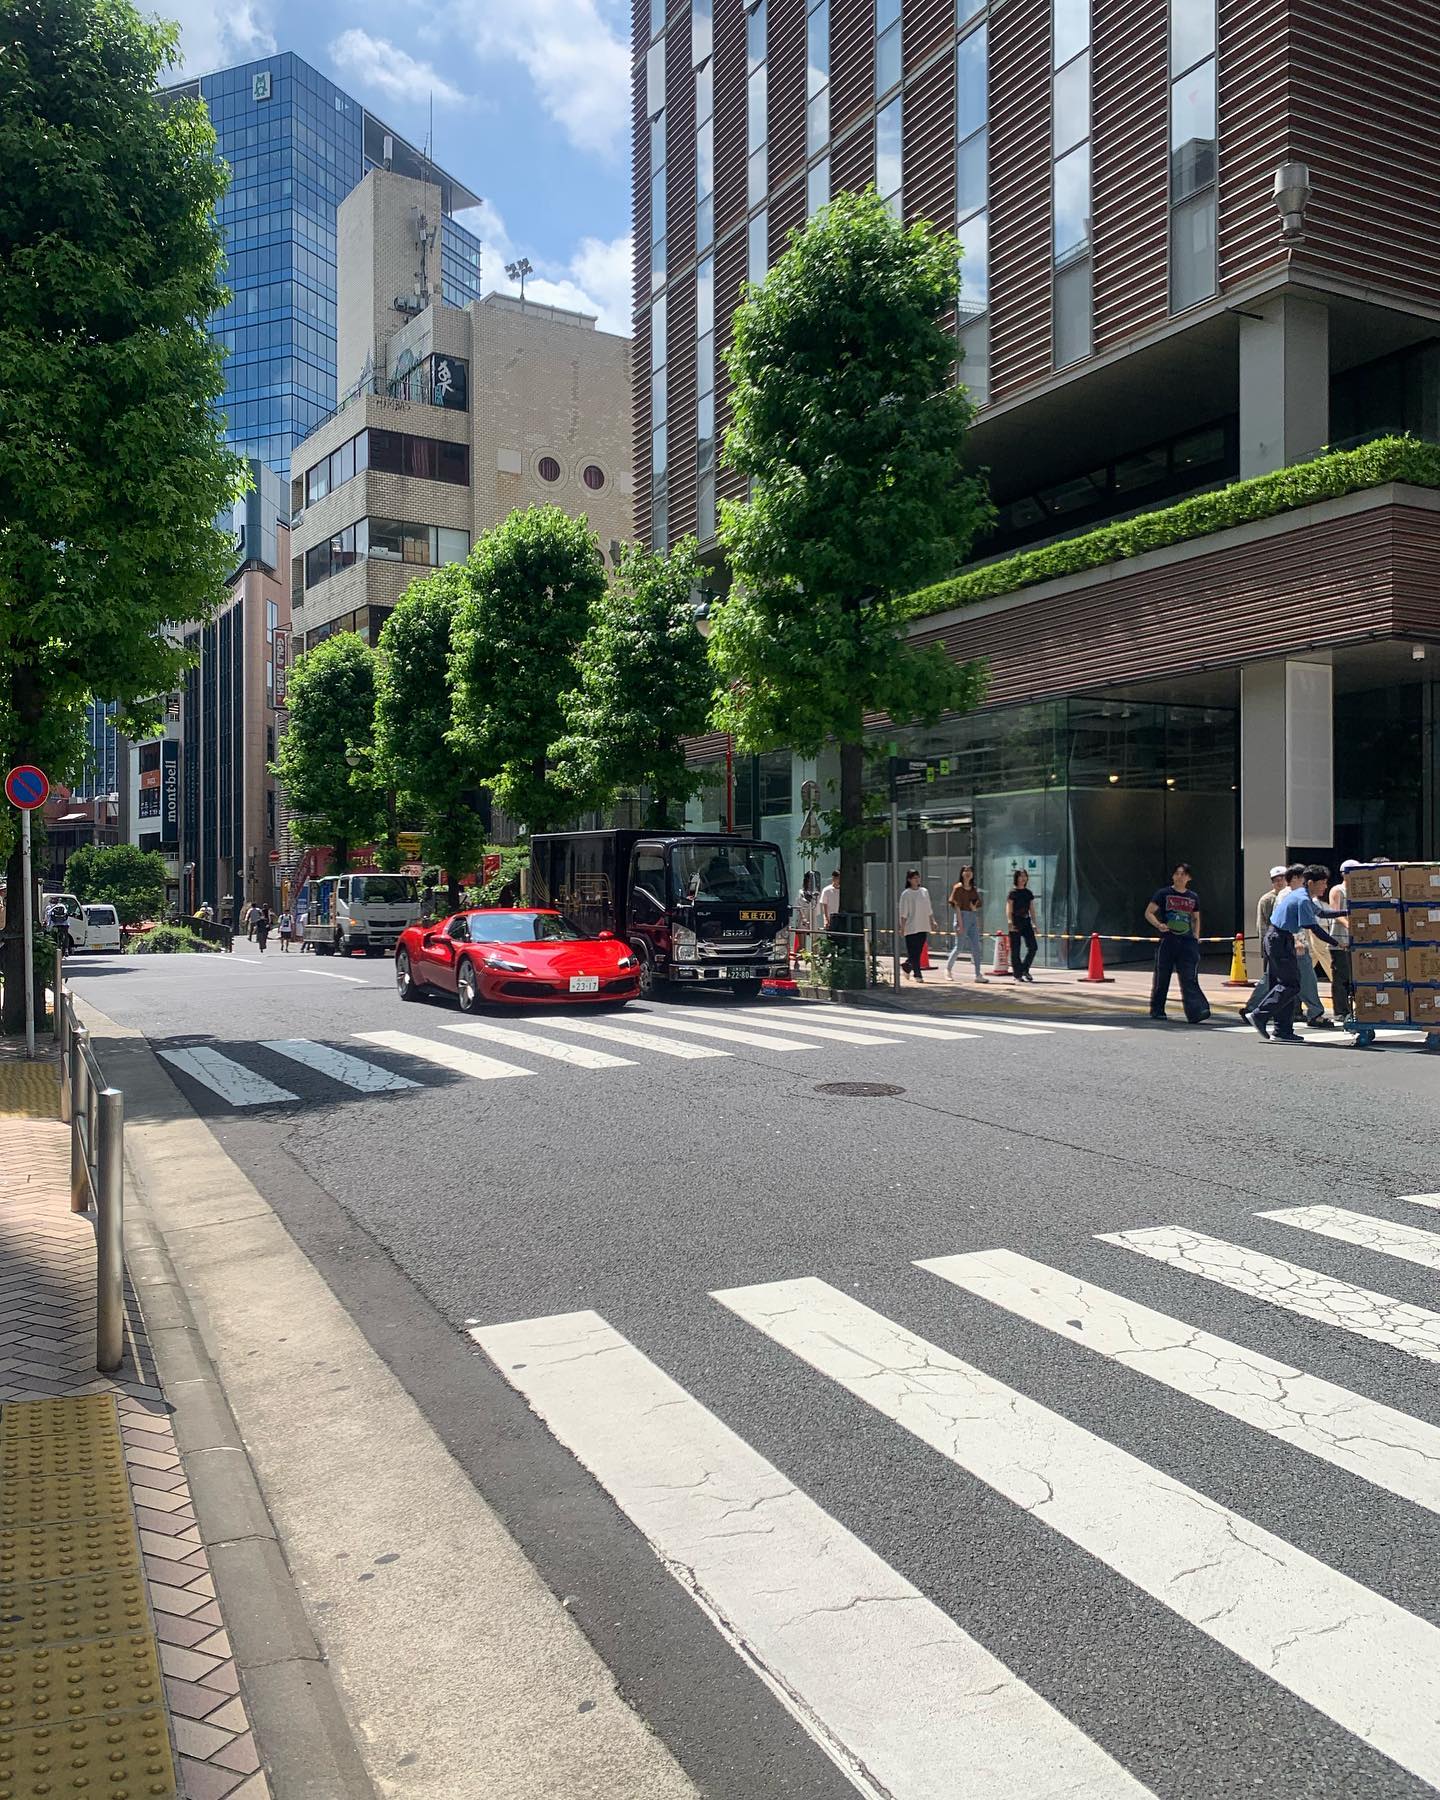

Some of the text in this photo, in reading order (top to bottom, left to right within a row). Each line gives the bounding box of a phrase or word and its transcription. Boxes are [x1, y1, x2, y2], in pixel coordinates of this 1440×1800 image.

[276, 638, 285, 695] GOLD RUSH
[722, 929, 752, 937] ISUZU
